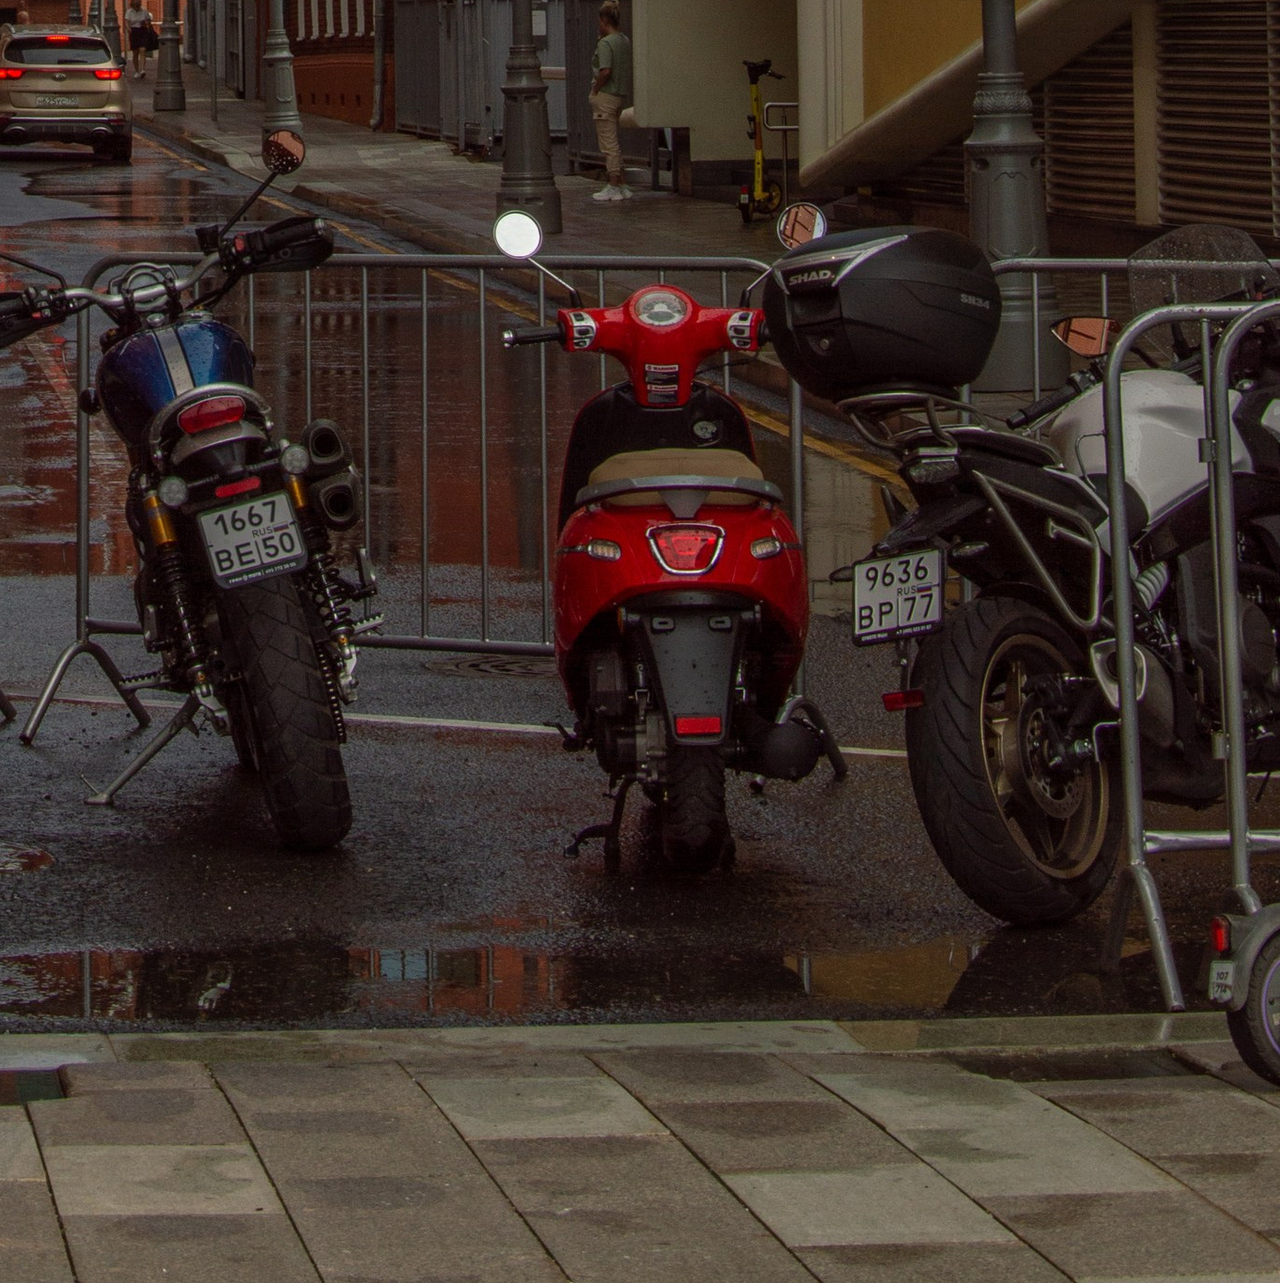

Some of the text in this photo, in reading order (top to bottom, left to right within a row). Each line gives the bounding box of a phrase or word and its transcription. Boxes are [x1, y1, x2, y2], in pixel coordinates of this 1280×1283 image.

[215, 500, 276, 534] 1667
[252, 526, 273, 538] RUS
[261, 532, 295, 558] 50
[866, 556, 928, 591] 9636
[897, 586, 916, 596] RUS
[904, 593, 933, 621] 77
